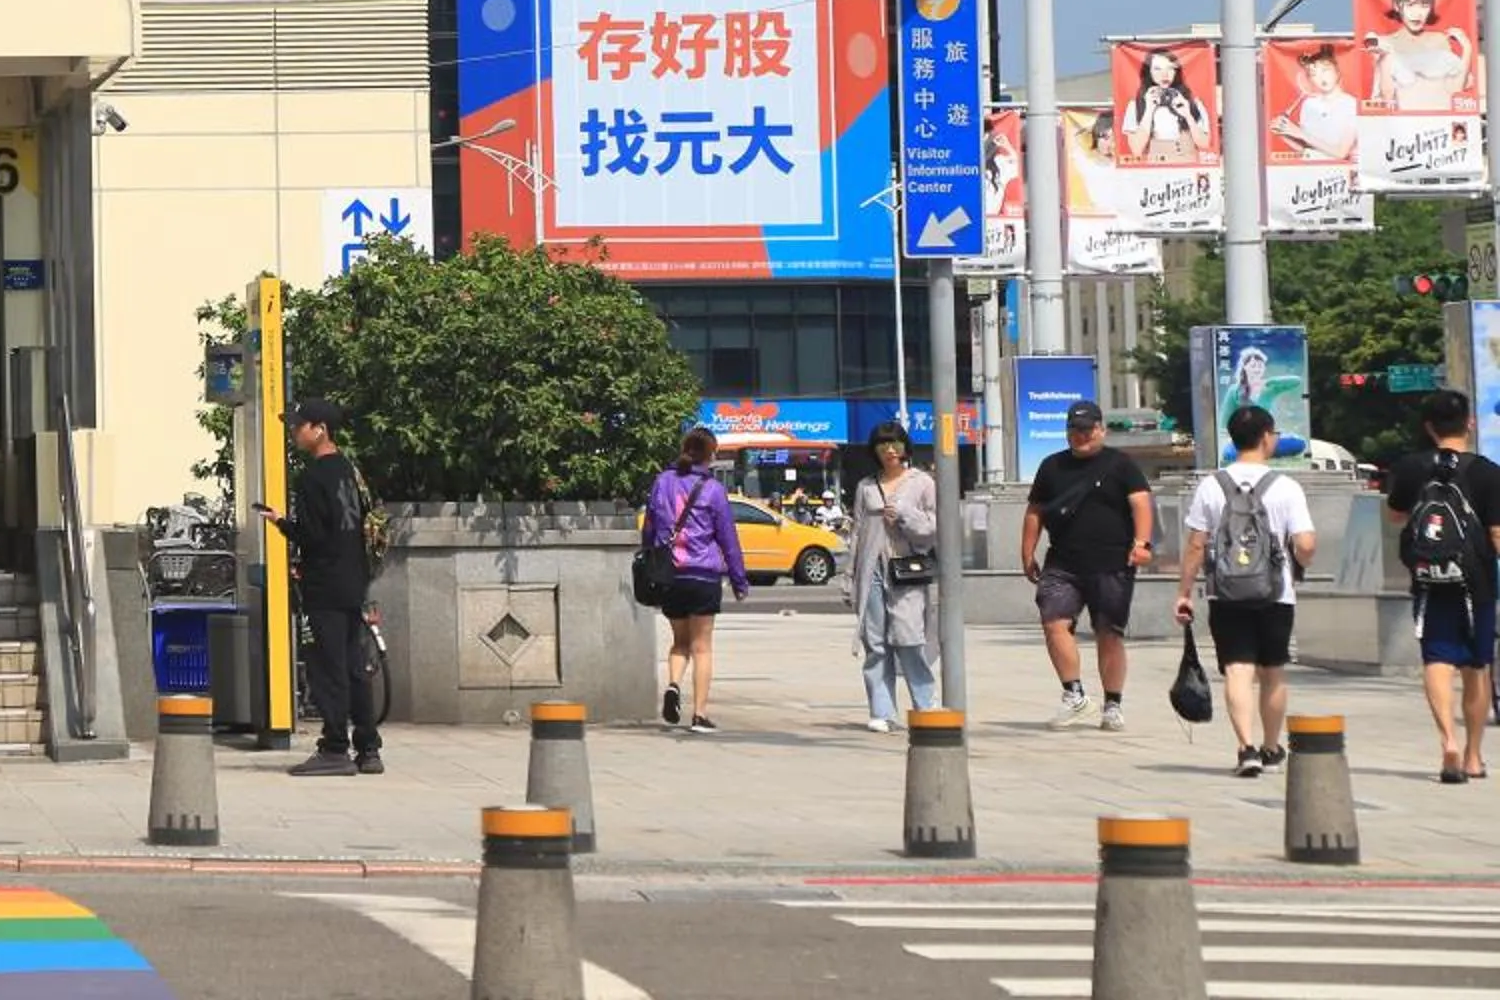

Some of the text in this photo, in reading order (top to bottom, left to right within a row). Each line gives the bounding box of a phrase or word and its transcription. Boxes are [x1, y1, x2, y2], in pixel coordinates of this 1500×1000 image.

[577, 11, 792, 80] 存好股
[911, 27, 937, 140] 服務中心
[945, 40, 970, 127] 旅遊
[580, 107, 795, 176] 找元大
[907, 146, 952, 160] Visitor
[907, 163, 980, 178] Information
[908, 180, 953, 194] Center
